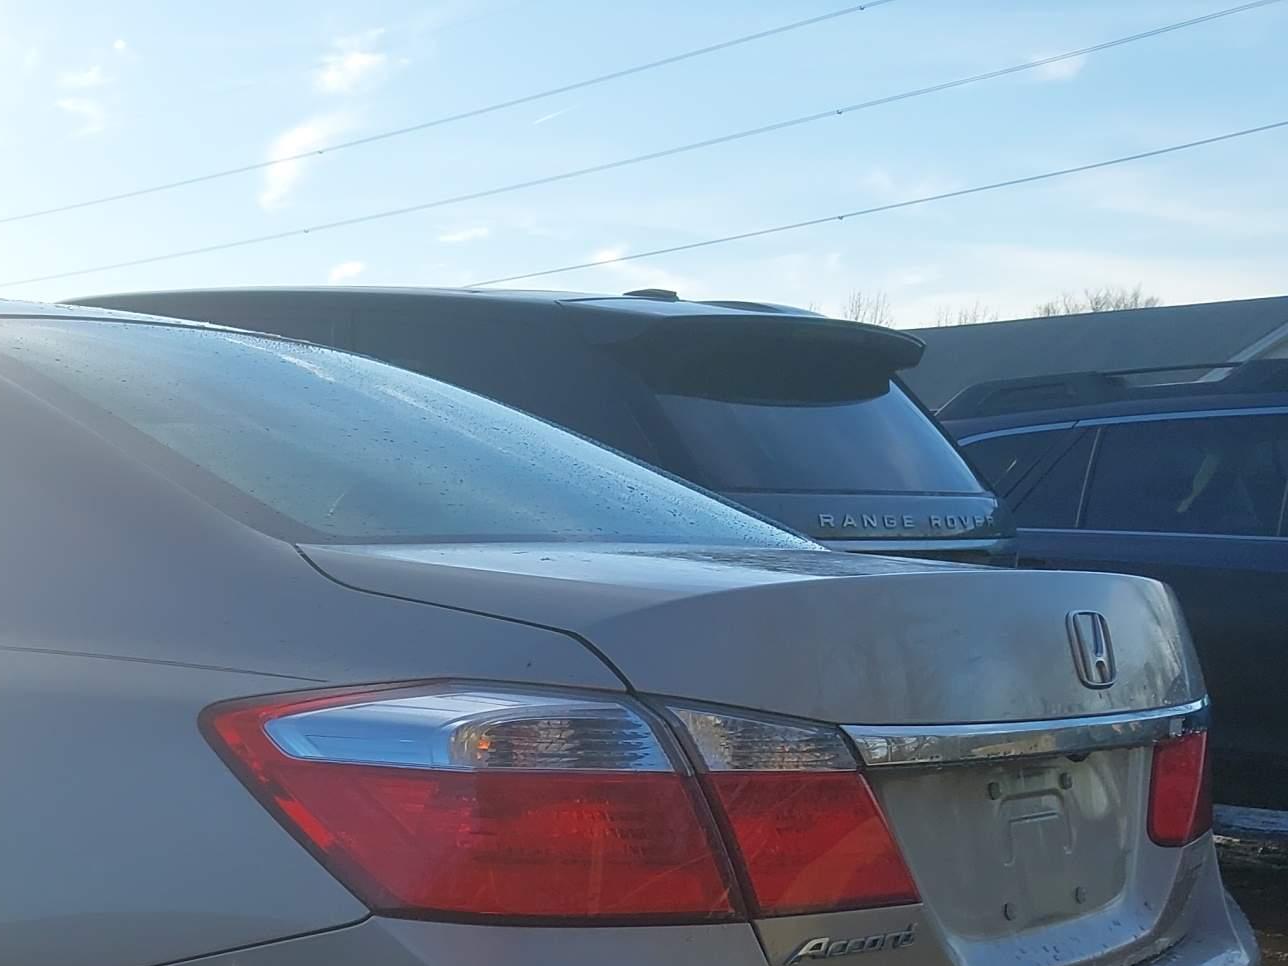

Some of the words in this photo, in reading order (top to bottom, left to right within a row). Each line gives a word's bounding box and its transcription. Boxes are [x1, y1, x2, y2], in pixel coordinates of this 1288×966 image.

[818, 513, 916, 528] RANGE
[929, 514, 995, 528] ROVER
[783, 922, 919, 966] Accord
